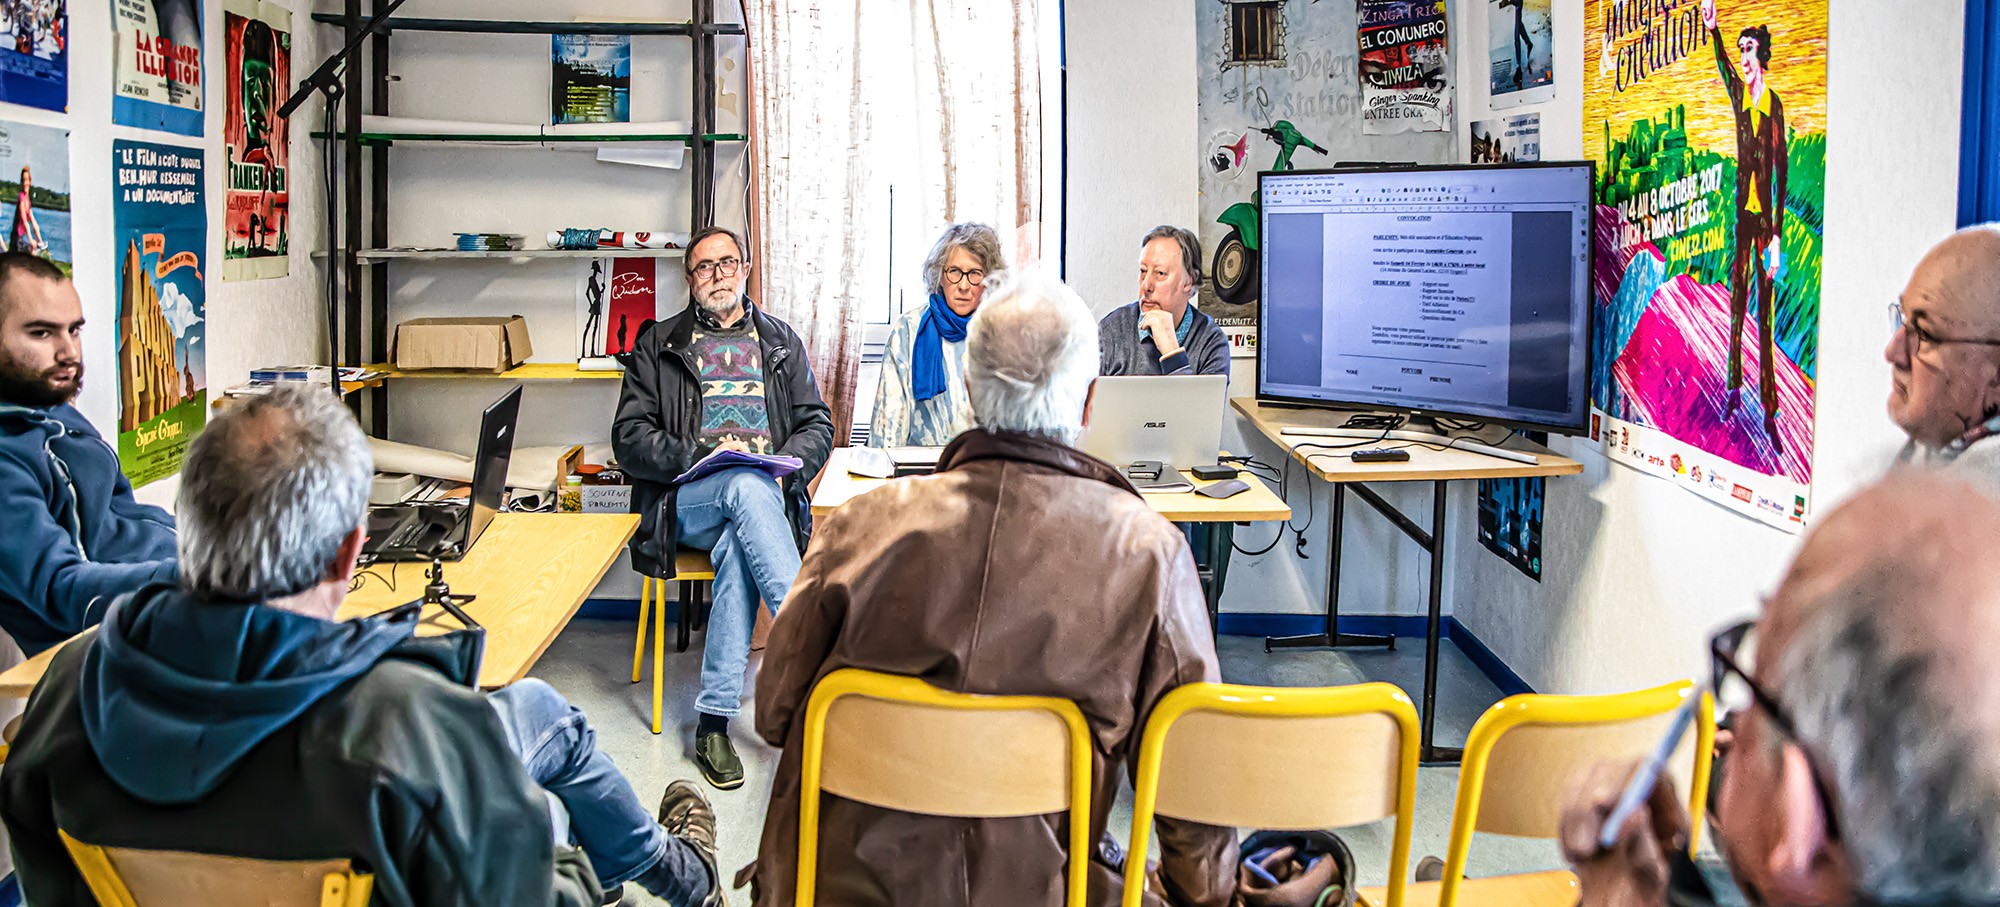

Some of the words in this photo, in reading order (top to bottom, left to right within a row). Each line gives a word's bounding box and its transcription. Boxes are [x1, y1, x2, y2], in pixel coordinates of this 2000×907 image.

[1360, 35, 1374, 49] EL
[1377, 20, 1446, 46] COMUNERO
[136, 29, 152, 53] LA
[155, 35, 199, 67] GRANDE
[136, 51, 199, 87] ILLUSION
[1369, 94, 1397, 108] Ginger
[1399, 91, 1441, 109] Spanking
[181, 158, 202, 170] DUQUEL
[160, 172, 196, 186] RESSEMBLE
[132, 188, 144, 203] UN
[1618, 200, 1628, 225] DU
[1628, 195, 1636, 220] 4
[1637, 192, 1649, 219] AU
[1650, 188, 1657, 216] 8
[1659, 173, 1698, 210] OCTOBRE
[1700, 162, 1723, 195] 2017
[1620, 222, 1641, 250] AUCH
[1643, 217, 1650, 243] &
[1651, 211, 1674, 240] DANS
[1675, 206, 1687, 233] LE
[1688, 198, 1709, 229] GERS
[1647, 455, 1665, 467] arte
[588, 500, 629, 509] PARLEMTV
